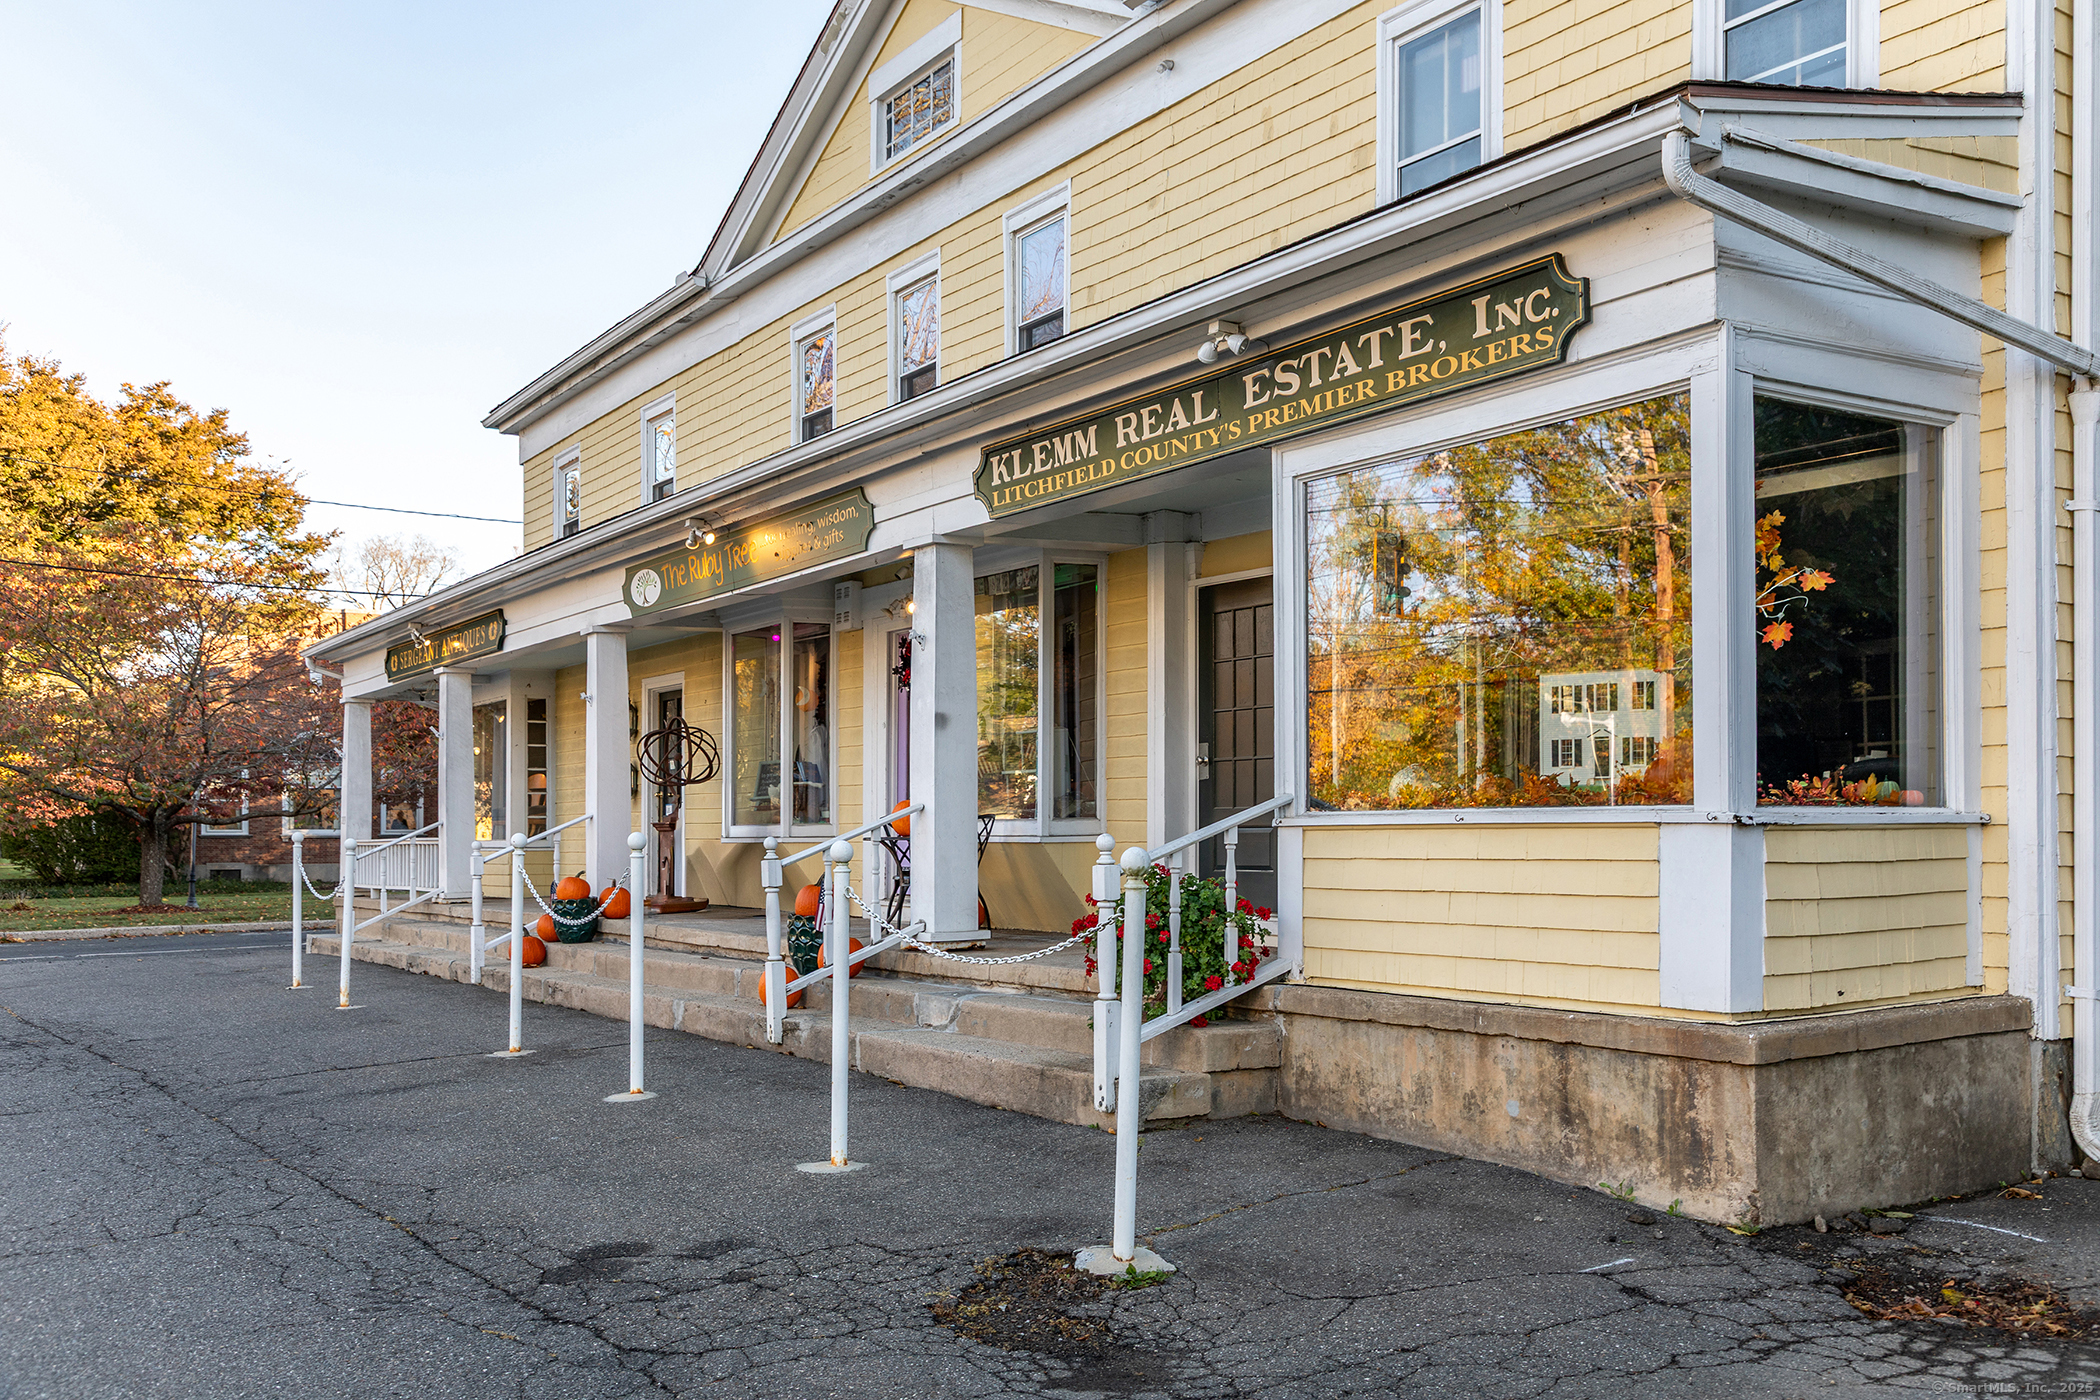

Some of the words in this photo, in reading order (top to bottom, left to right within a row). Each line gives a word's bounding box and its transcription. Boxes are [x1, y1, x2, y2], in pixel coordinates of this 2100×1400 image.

[990, 424, 1099, 486] KLEMM
[1114, 390, 1218, 448] REAL
[1242, 314, 1447, 409] ESTATE,
[992, 458, 1116, 507] LITCHFIELD
[1120, 419, 1242, 470] COUNTY'S
[1247, 379, 1377, 435] PREMIER
[1385, 325, 1554, 394] BROKERS
[817, 506, 859, 529] wisdom,
[814, 536, 821, 550] &
[823, 529, 844, 551] gifts
[661, 563, 687, 590] The
[688, 551, 724, 586] Ruby
